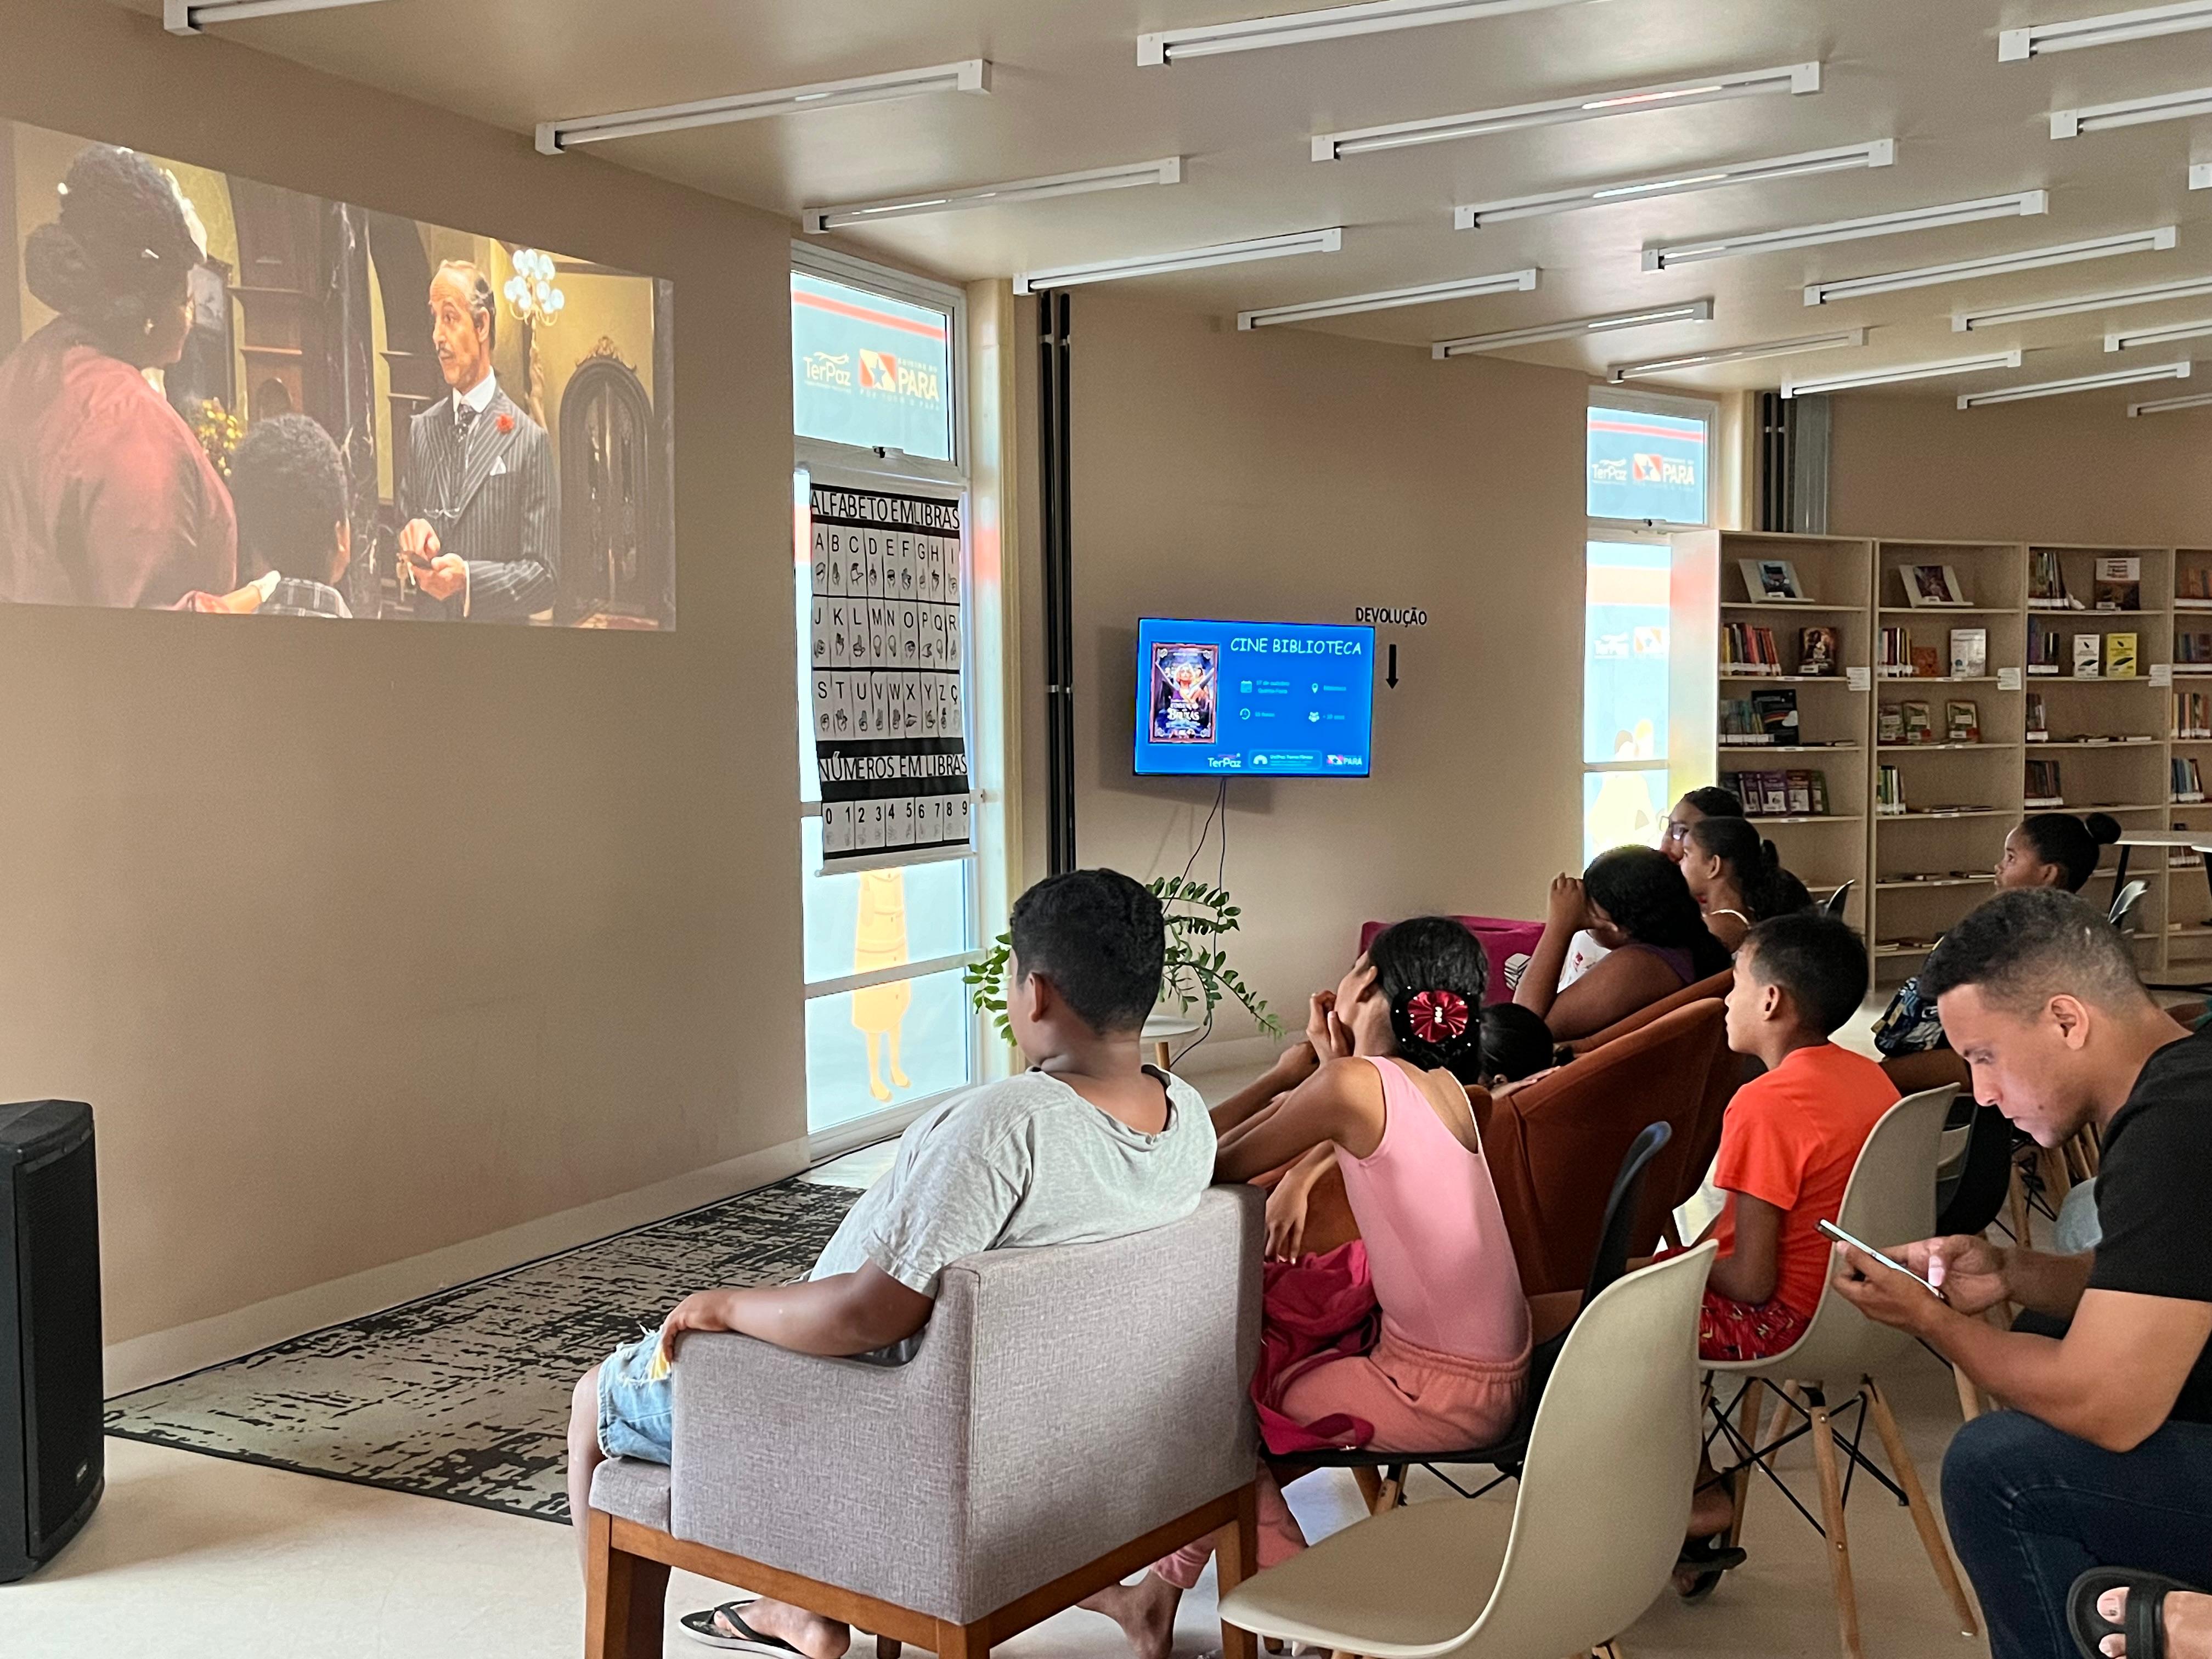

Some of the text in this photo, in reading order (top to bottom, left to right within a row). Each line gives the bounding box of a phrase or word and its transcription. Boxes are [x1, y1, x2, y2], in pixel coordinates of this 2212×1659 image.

[803, 357, 851, 386] TerPaz
[811, 491, 960, 529] ALFABETO EM LIBRAS
[815, 533, 824, 551] A
[832, 535, 839, 551] B
[849, 536, 859, 553] C
[869, 538, 877, 555] D
[887, 539, 894, 556] E
[902, 541, 909, 557] F
[918, 543, 925, 560] G
[931, 545, 939, 562] H
[815, 607, 957, 631] J K L M N O P Q R
[1356, 607, 1427, 628] DEVOLUÇÃO
[1231, 637, 1362, 655] CINE BIBLIOTECA
[818, 681, 957, 705] S T U V W X Y Z Ç
[819, 751, 967, 781] NÚMEROS EM LIBRAS
[1207, 758, 1242, 768] TerPaz
[826, 808, 832, 825] 0
[858, 808, 865, 823] 2
[876, 806, 882, 821] 3
[888, 804, 894, 819] 4
[906, 803, 912, 817] 5
[918, 804, 924, 819] 6
[935, 803, 940, 817] 7
[947, 802, 952, 816] 8
[962, 801, 968, 815] 9
